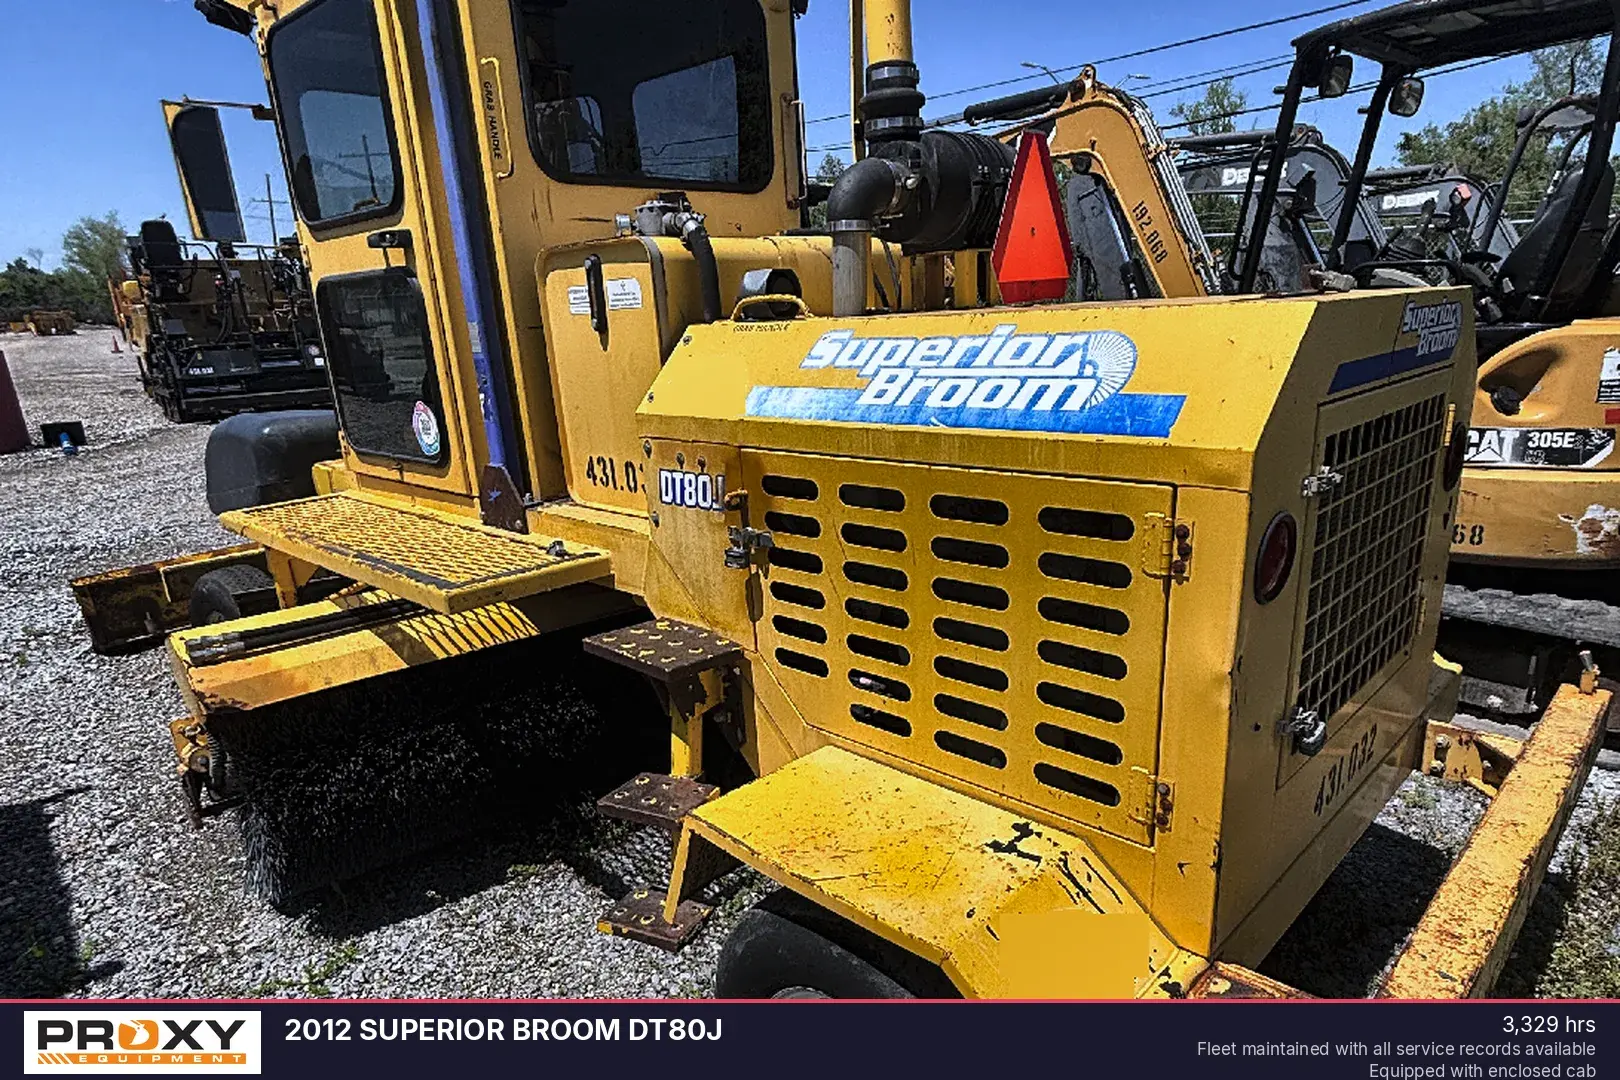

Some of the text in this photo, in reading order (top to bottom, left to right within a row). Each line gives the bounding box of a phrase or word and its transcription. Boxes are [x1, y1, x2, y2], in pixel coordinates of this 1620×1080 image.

[484, 81, 503, 160] GRAB HANDLE
[1402, 298, 1460, 335] Superior
[800, 324, 1091, 377] Superior
[1416, 328, 1459, 357] Broom
[858, 367, 1099, 411] Broom
[1464, 430, 1520, 463] CAT
[586, 455, 647, 494] 431.0
[659, 469, 726, 511] DT80J
[1314, 723, 1377, 817] 431.032
